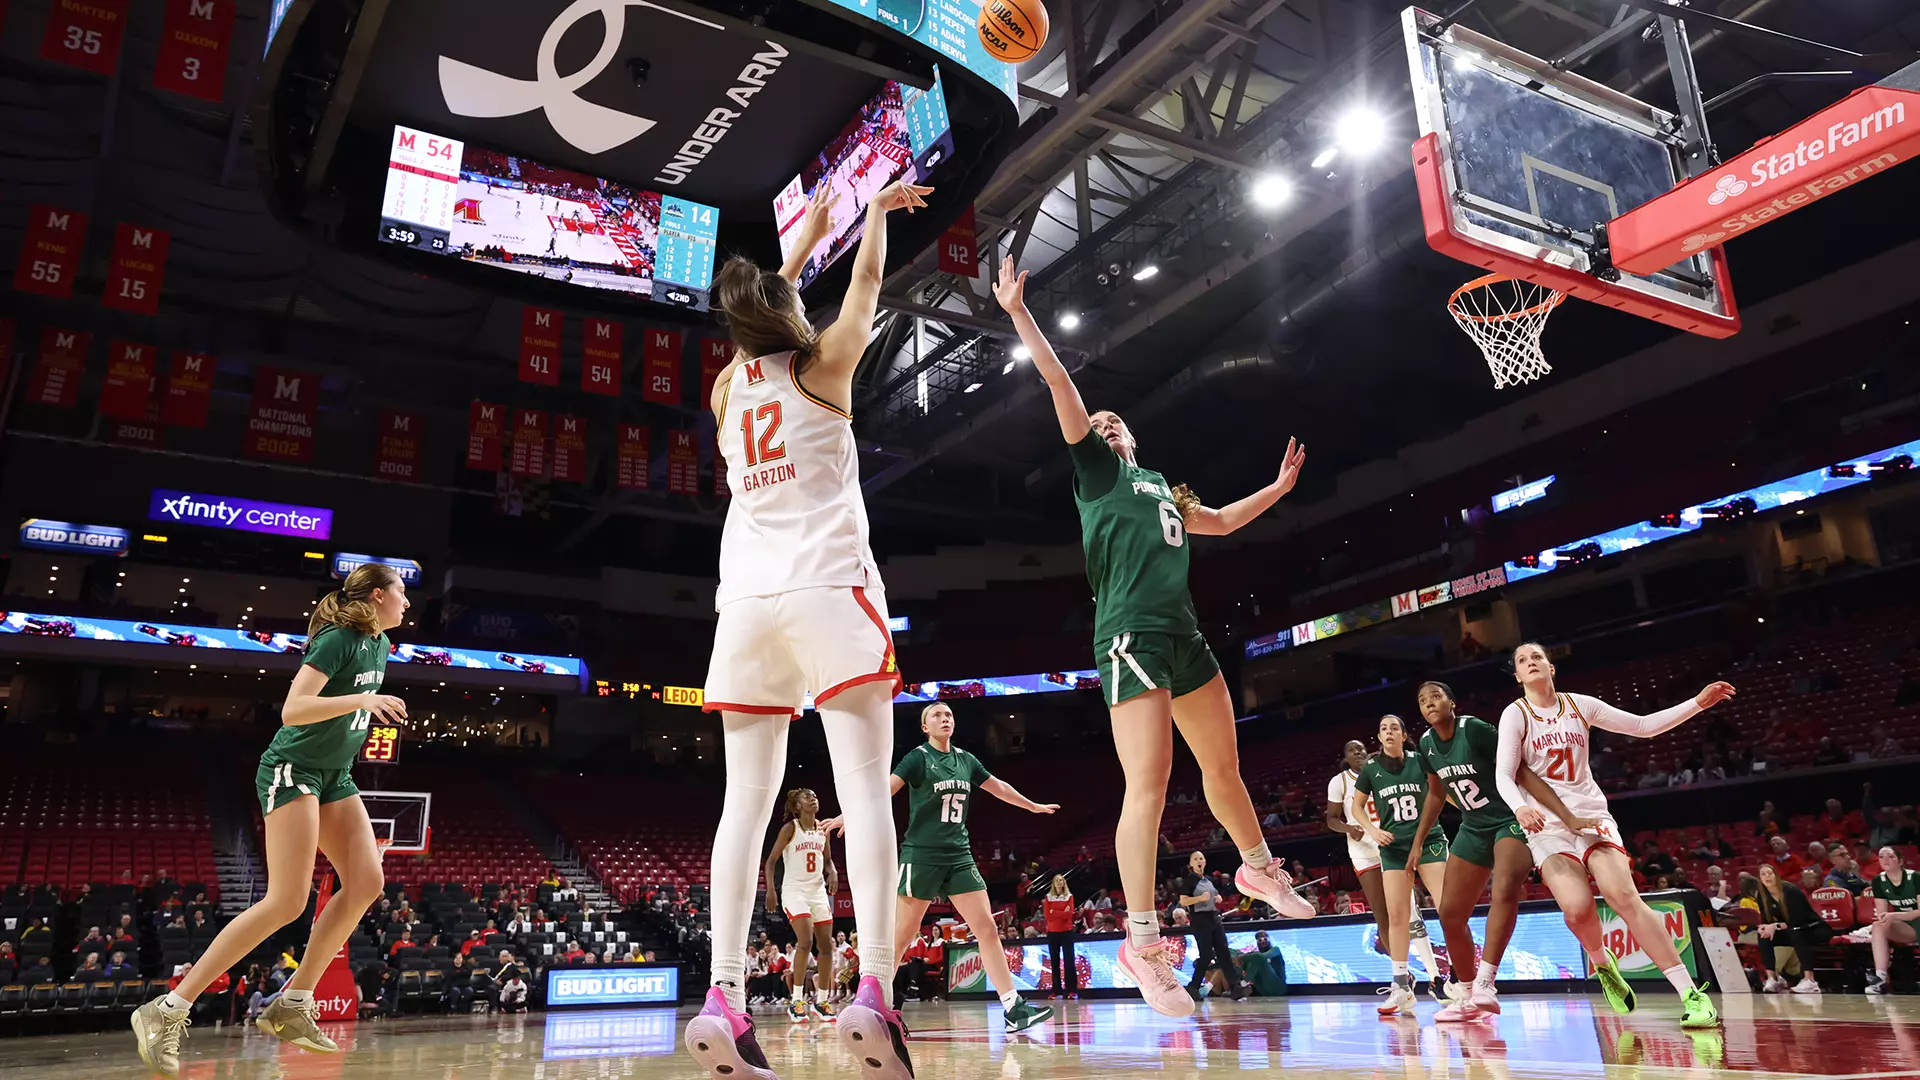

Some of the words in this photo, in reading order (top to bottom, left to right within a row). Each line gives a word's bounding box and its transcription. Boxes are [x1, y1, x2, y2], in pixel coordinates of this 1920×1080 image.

[61, 0, 117, 22] BAXTER
[189, 0, 215, 20] M
[878, 8, 899, 24] FOULS
[903, 18, 908, 31] 1
[990, 0, 1025, 39] Wilson
[928, 6, 938, 18] 13
[940, 13, 966, 35] PIEPER
[63, 25, 102, 55] 35
[175, 30, 219, 50] DIXON
[928, 21, 938, 32] 15
[940, 28, 966, 49] ADAMS
[980, 23, 1008, 51] NCAA
[928, 35, 938, 47] 18
[940, 41, 968, 64] HERVIA
[182, 57, 200, 81] 3
[399, 131, 416, 150] M
[427, 138, 452, 161] 54
[653, 107, 742, 184] UNDER
[786, 182, 799, 206] 54
[46, 212, 70, 231] M
[665, 220, 680, 230] FOULS
[691, 206, 712, 227] 14
[132, 230, 153, 249] M
[389, 228, 415, 243] 3:59
[432, 239, 444, 249] 23
[664, 228, 680, 238] PLAYER
[668, 237, 673, 245] 6
[665, 254, 674, 263] 13
[666, 246, 675, 254] 12
[948, 243, 969, 265] 42
[31, 260, 62, 284] 55
[663, 271, 672, 280] 18
[664, 263, 673, 271] 15
[119, 278, 147, 300] 15
[675, 293, 690, 304] 2ND
[535, 312, 550, 328] M
[596, 322, 611, 339] M
[656, 333, 670, 349] M
[712, 342, 725, 358] M
[529, 355, 549, 374] 41
[744, 359, 765, 383] M
[591, 365, 612, 385] 54
[652, 375, 671, 393] 25
[273, 375, 301, 402] M
[258, 407, 308, 425] NATIONAL
[393, 415, 411, 432] M
[480, 406, 495, 421] M
[524, 412, 538, 427] M
[117, 425, 155, 441] 2001
[250, 418, 313, 438] CHAMPIONS
[564, 418, 577, 433] M
[627, 427, 641, 441] M
[741, 401, 786, 467] 12
[256, 437, 301, 457] 2002
[678, 433, 691, 447] M
[379, 461, 413, 477] 2002
[743, 463, 797, 491] GARZON
[1131, 482, 1161, 496] POINT
[161, 495, 243, 525] xfinity
[246, 509, 321, 531] center
[1158, 500, 1185, 547] 6
[26, 528, 67, 542] BUD
[69, 532, 124, 549] LIGHT
[1397, 591, 1413, 612] M
[1298, 624, 1311, 641] M
[354, 671, 376, 687] POINT
[664, 687, 698, 704] LEDO
[372, 727, 398, 740] 3:58
[1532, 731, 1585, 753] MARYLAND
[365, 739, 392, 760] 23
[1451, 764, 1477, 776] PARK
[1546, 747, 1575, 781] 21
[934, 780, 955, 793] POINT
[1379, 785, 1398, 799] POINT
[1399, 783, 1421, 793] PARK
[1448, 779, 1490, 811] 12
[941, 794, 967, 823] 15
[1388, 795, 1419, 822] 18
[806, 852, 816, 873] 8
[1812, 891, 1846, 900] MARYLAND
[557, 979, 602, 996] BUD
[604, 977, 665, 994] LIGHT
